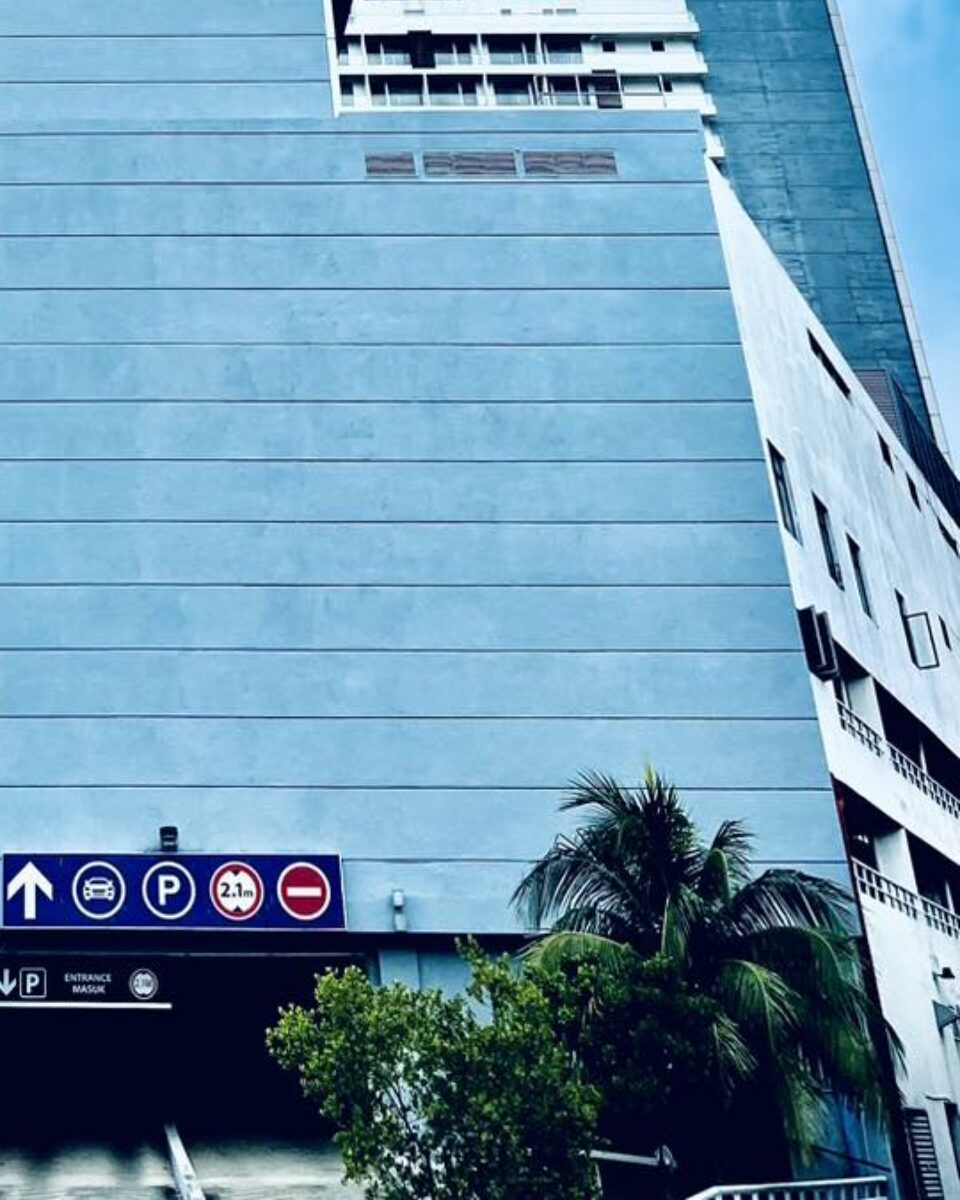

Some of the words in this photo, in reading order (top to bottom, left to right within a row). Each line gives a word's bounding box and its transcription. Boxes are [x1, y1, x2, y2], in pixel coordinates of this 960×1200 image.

[157, 874, 181, 906] P
[220, 881, 254, 898] 2.1m
[25, 973, 41, 994] P
[64, 972, 112, 983] ENTRANCE
[72, 984, 106, 994] MASUK
